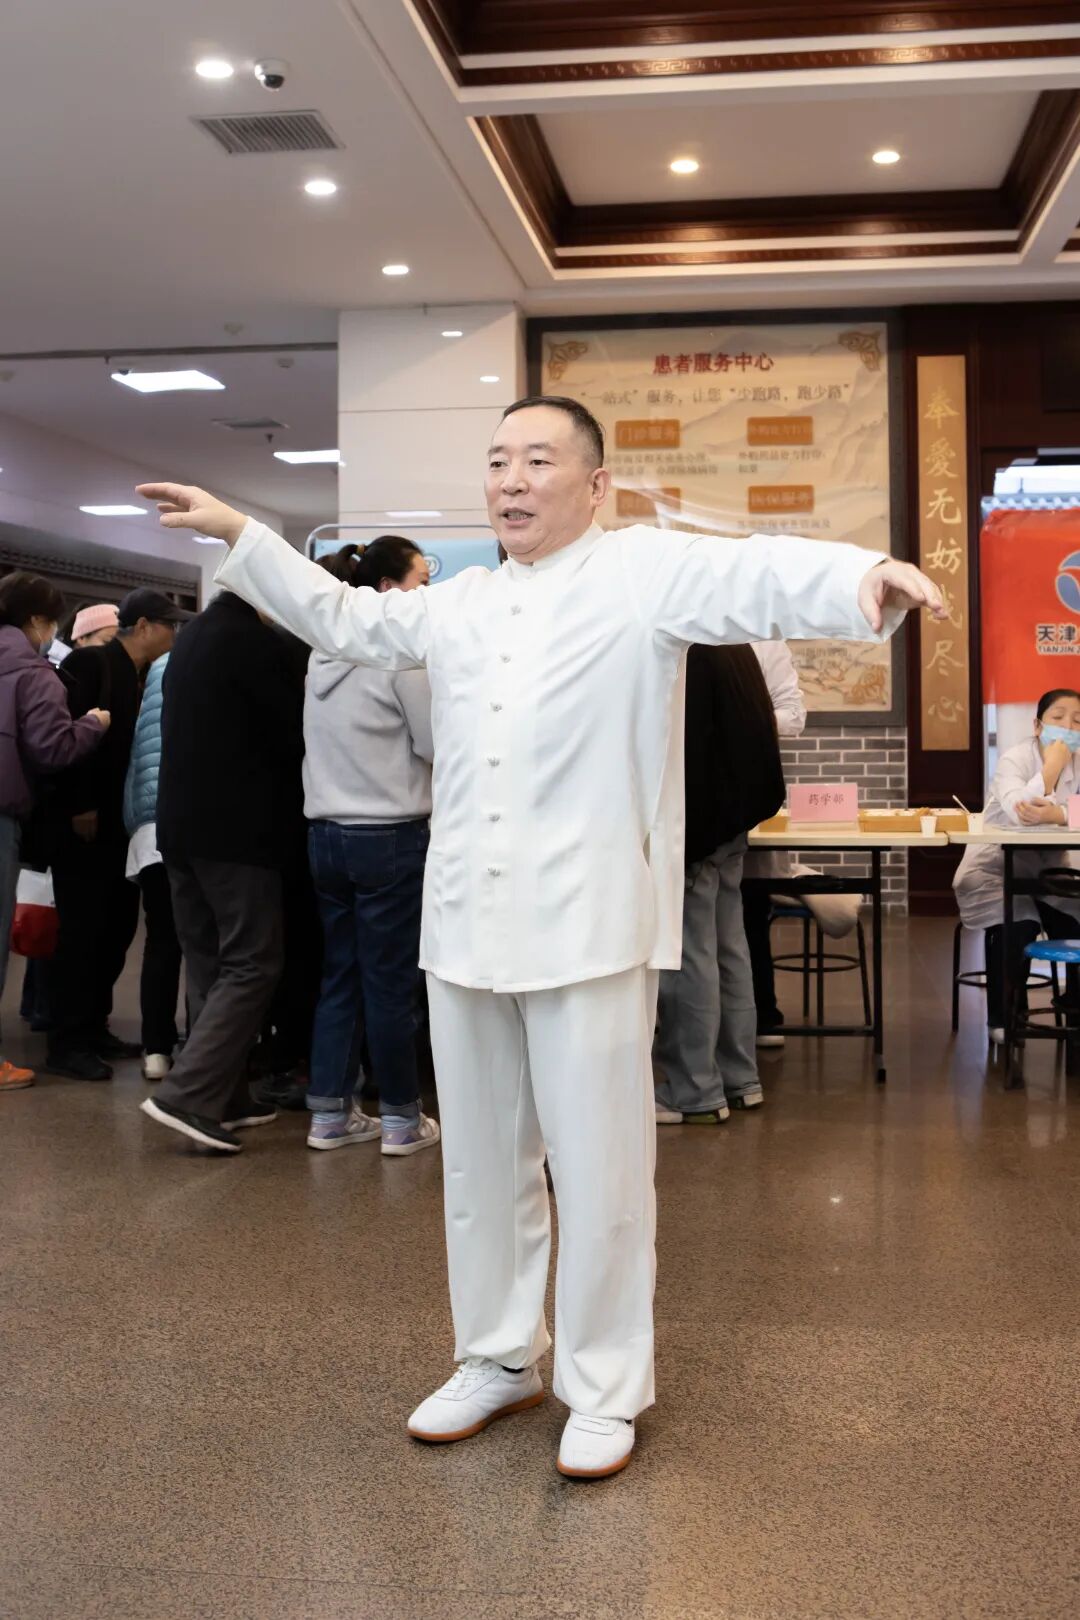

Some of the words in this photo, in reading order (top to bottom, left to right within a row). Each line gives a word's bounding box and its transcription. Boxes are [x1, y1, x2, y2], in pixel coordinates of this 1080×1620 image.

[653, 352, 775, 375] 患者服务中心
[1038, 645, 1074, 654] TIANJIN
[808, 792, 845, 806] 药学部
